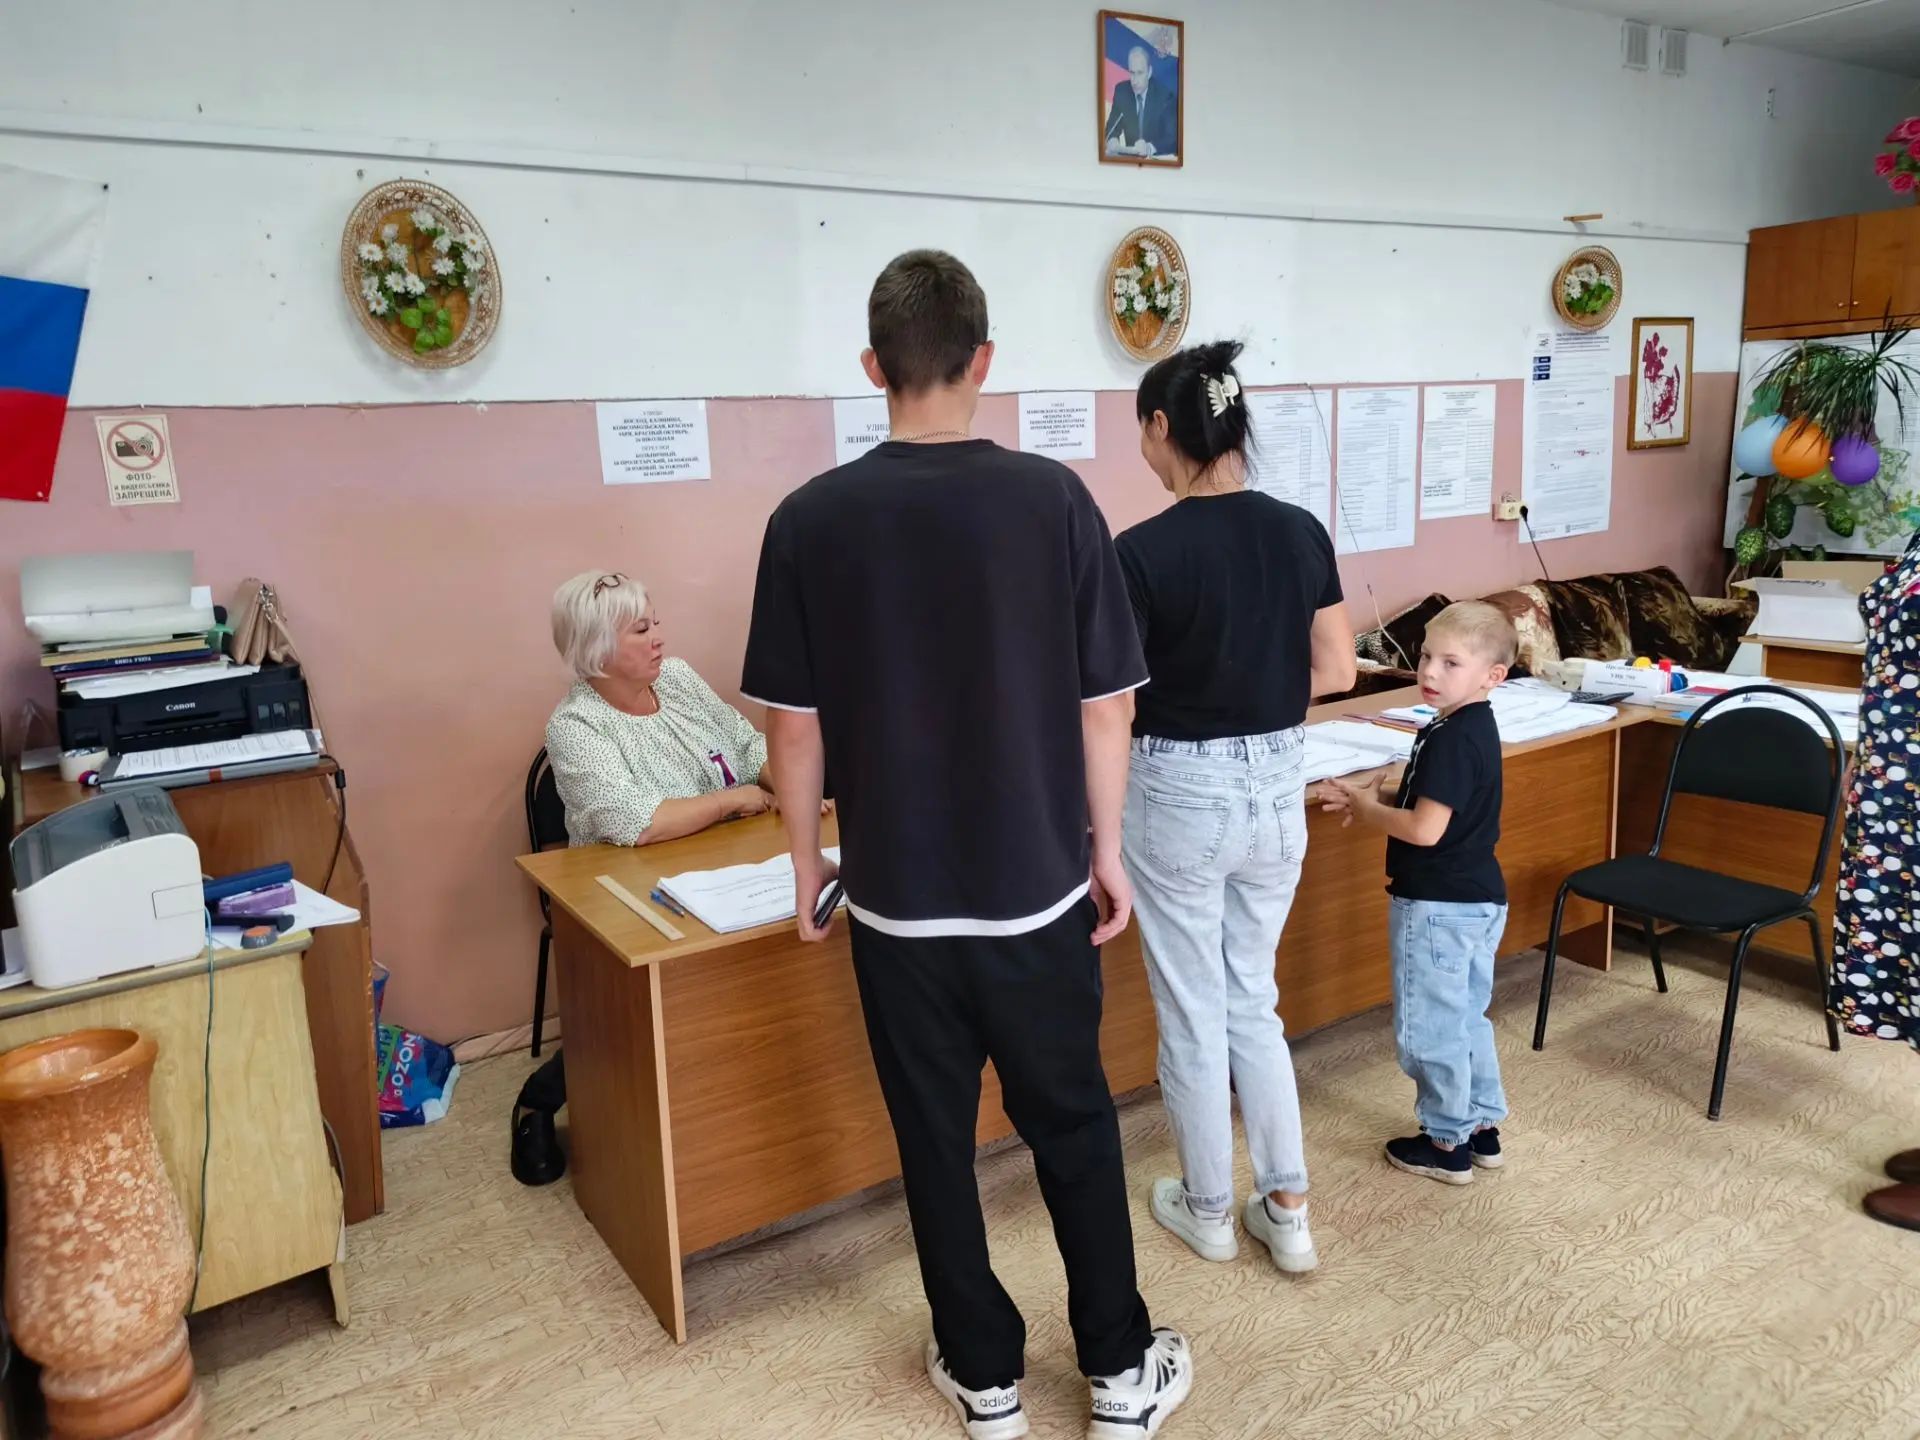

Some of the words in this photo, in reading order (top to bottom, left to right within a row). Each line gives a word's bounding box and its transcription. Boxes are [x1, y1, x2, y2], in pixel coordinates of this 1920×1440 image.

[845, 435, 881, 443] ЛЕНИНА,
[115, 489, 172, 500] ЗАПРЕЩЕНА
[165, 702, 195, 711] Canon
[392, 1032, 416, 1087] OZON
[979, 1389, 1016, 1407] adidas
